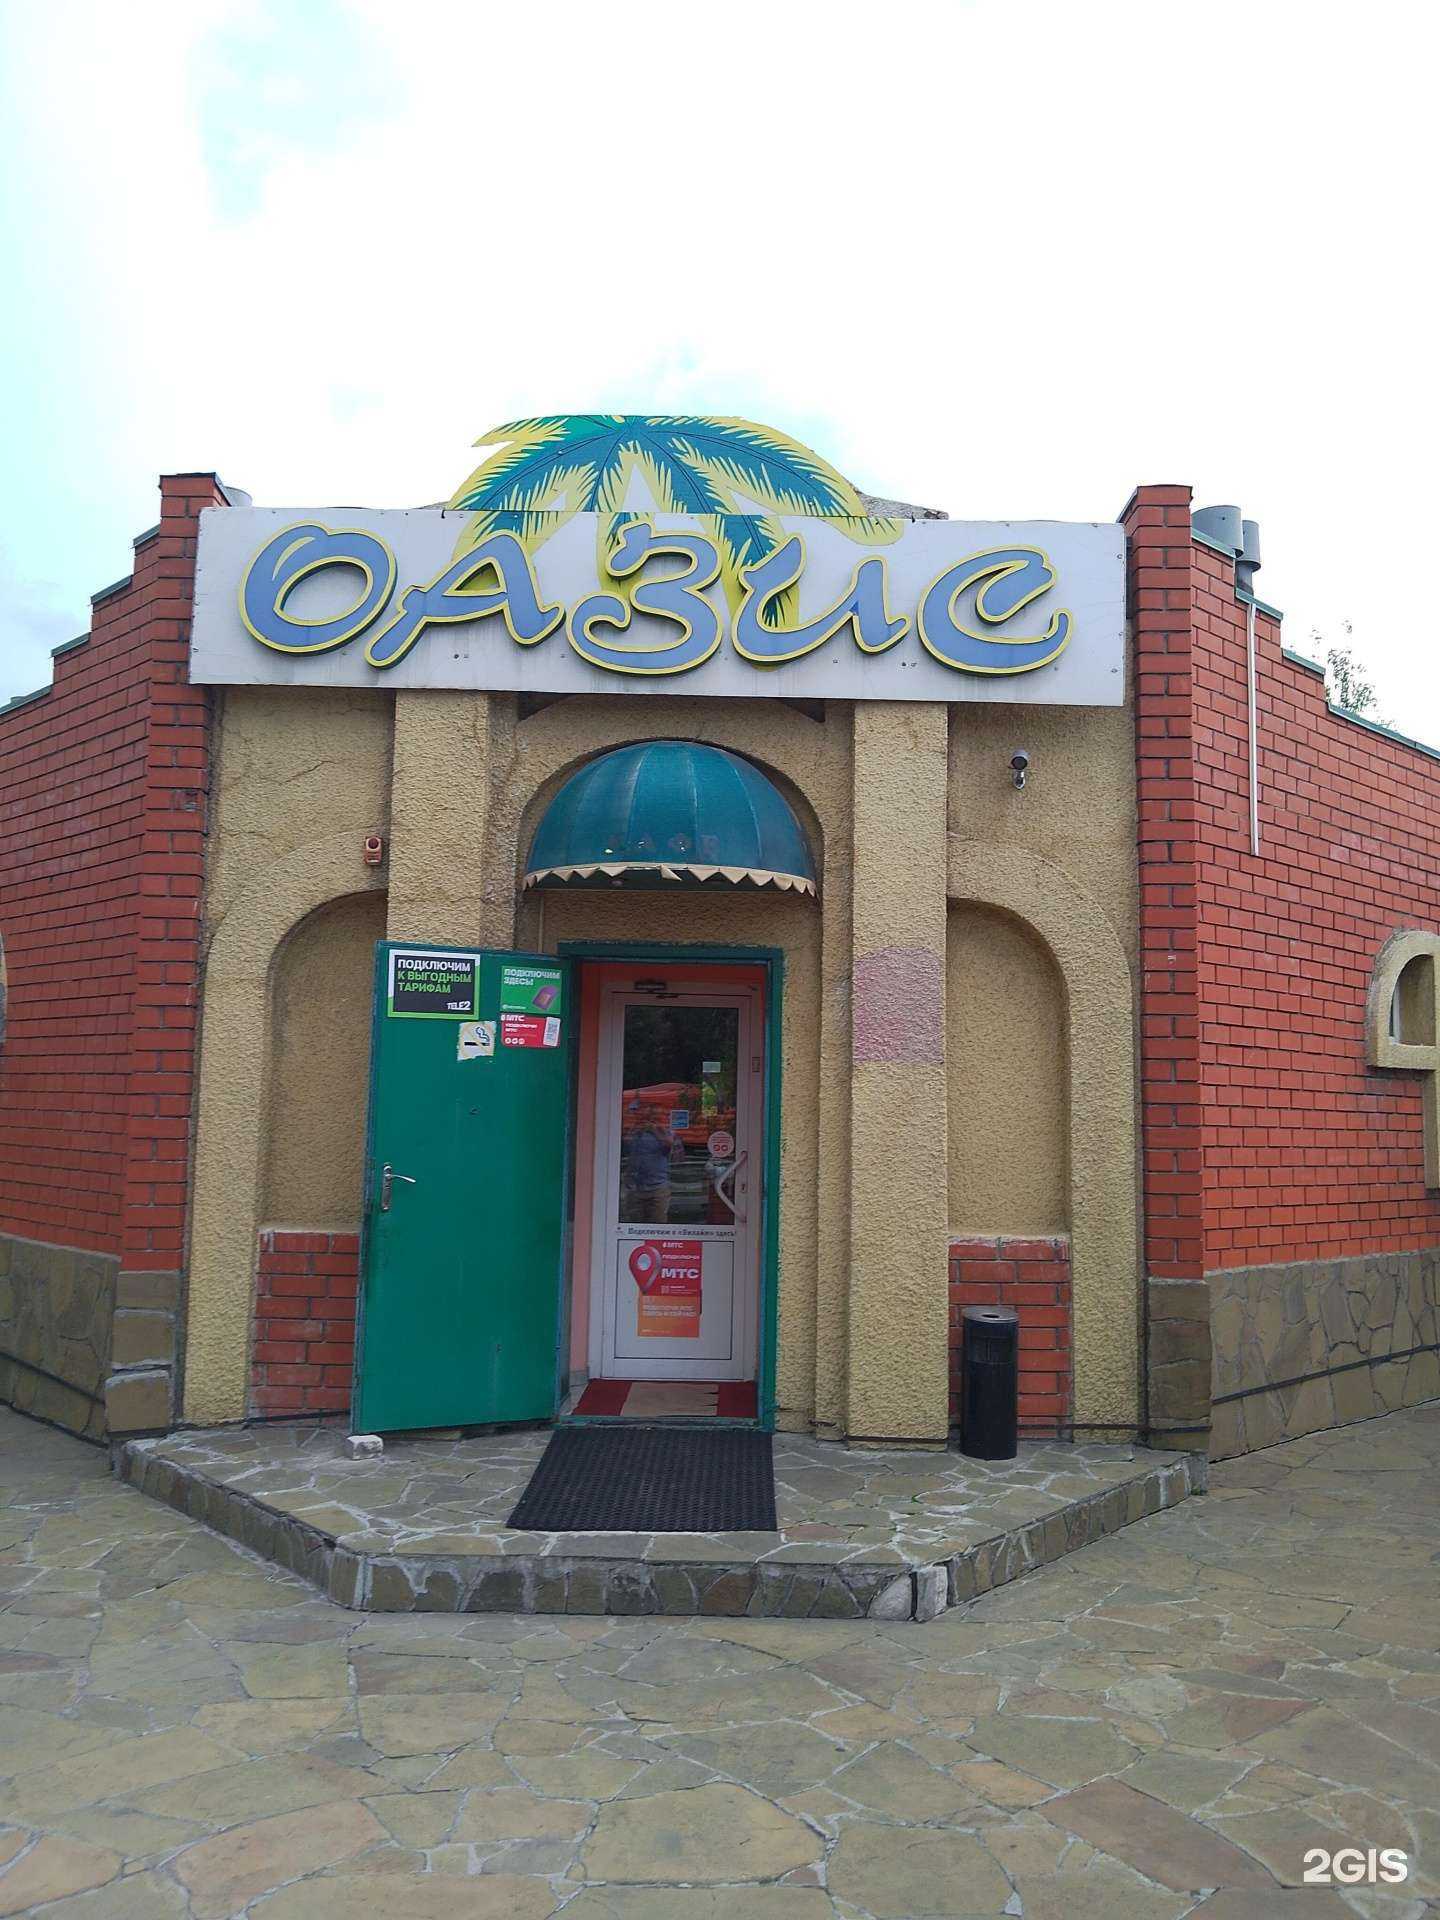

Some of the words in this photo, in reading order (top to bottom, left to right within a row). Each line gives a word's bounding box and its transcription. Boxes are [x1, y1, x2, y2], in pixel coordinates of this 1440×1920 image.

[397, 959, 471, 971] ПОДКЛЮЧИМ
[397, 971, 405, 980] К
[407, 971, 472, 983] ВЫГОДНЫМ
[504, 968, 560, 979] ПОДКЛЮЧИМ
[397, 982, 451, 993] ТАРИФАМ
[447, 1001, 471, 1010] TELE2
[661, 1268, 699, 1278] МТС
